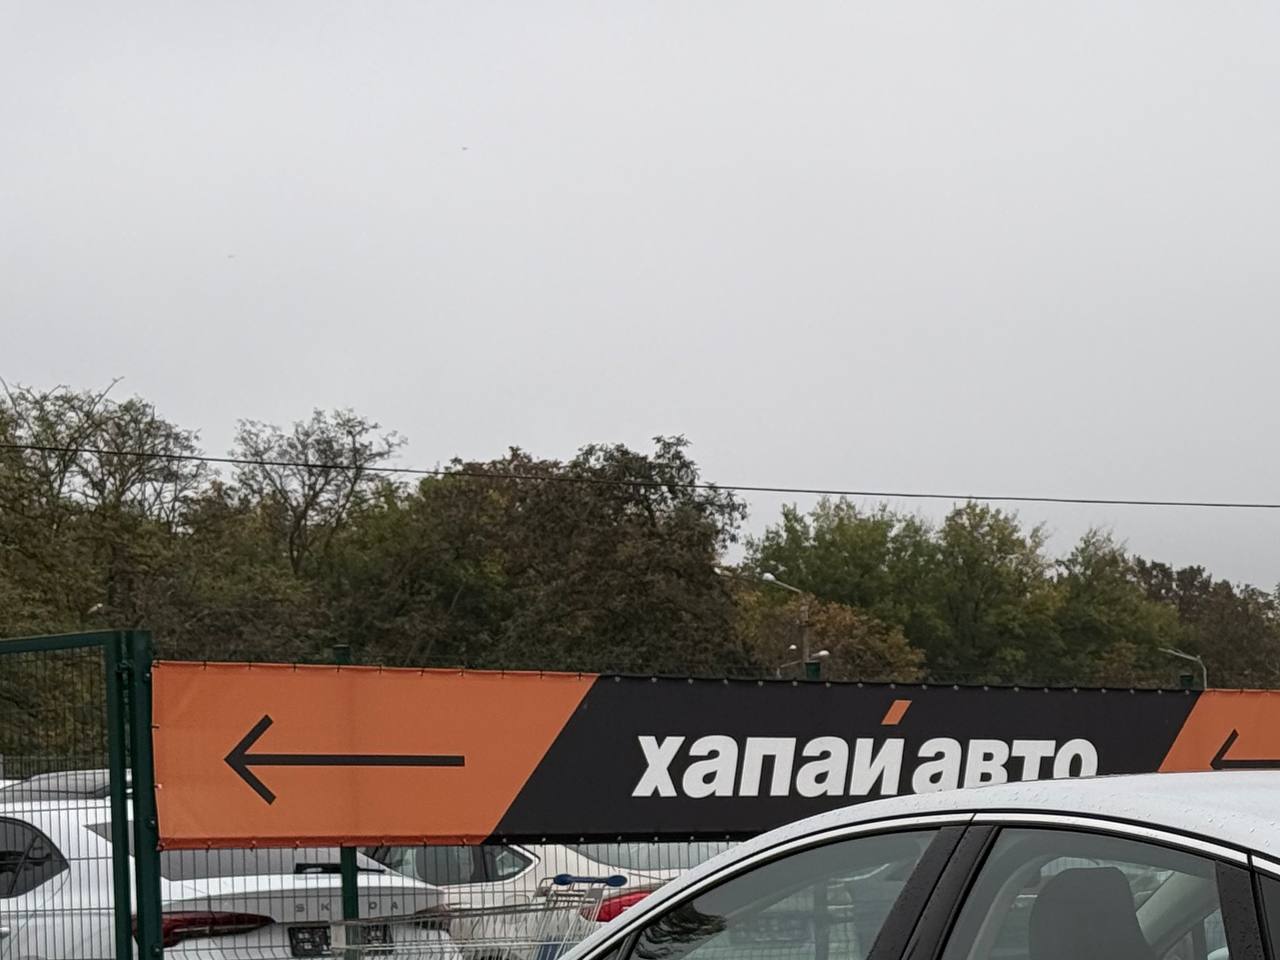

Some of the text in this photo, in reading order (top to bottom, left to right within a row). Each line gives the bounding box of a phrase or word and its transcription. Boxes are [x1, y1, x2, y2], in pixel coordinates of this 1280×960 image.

[632, 700, 1099, 798] хапай авто
[295, 902, 399, 912] SKDA
